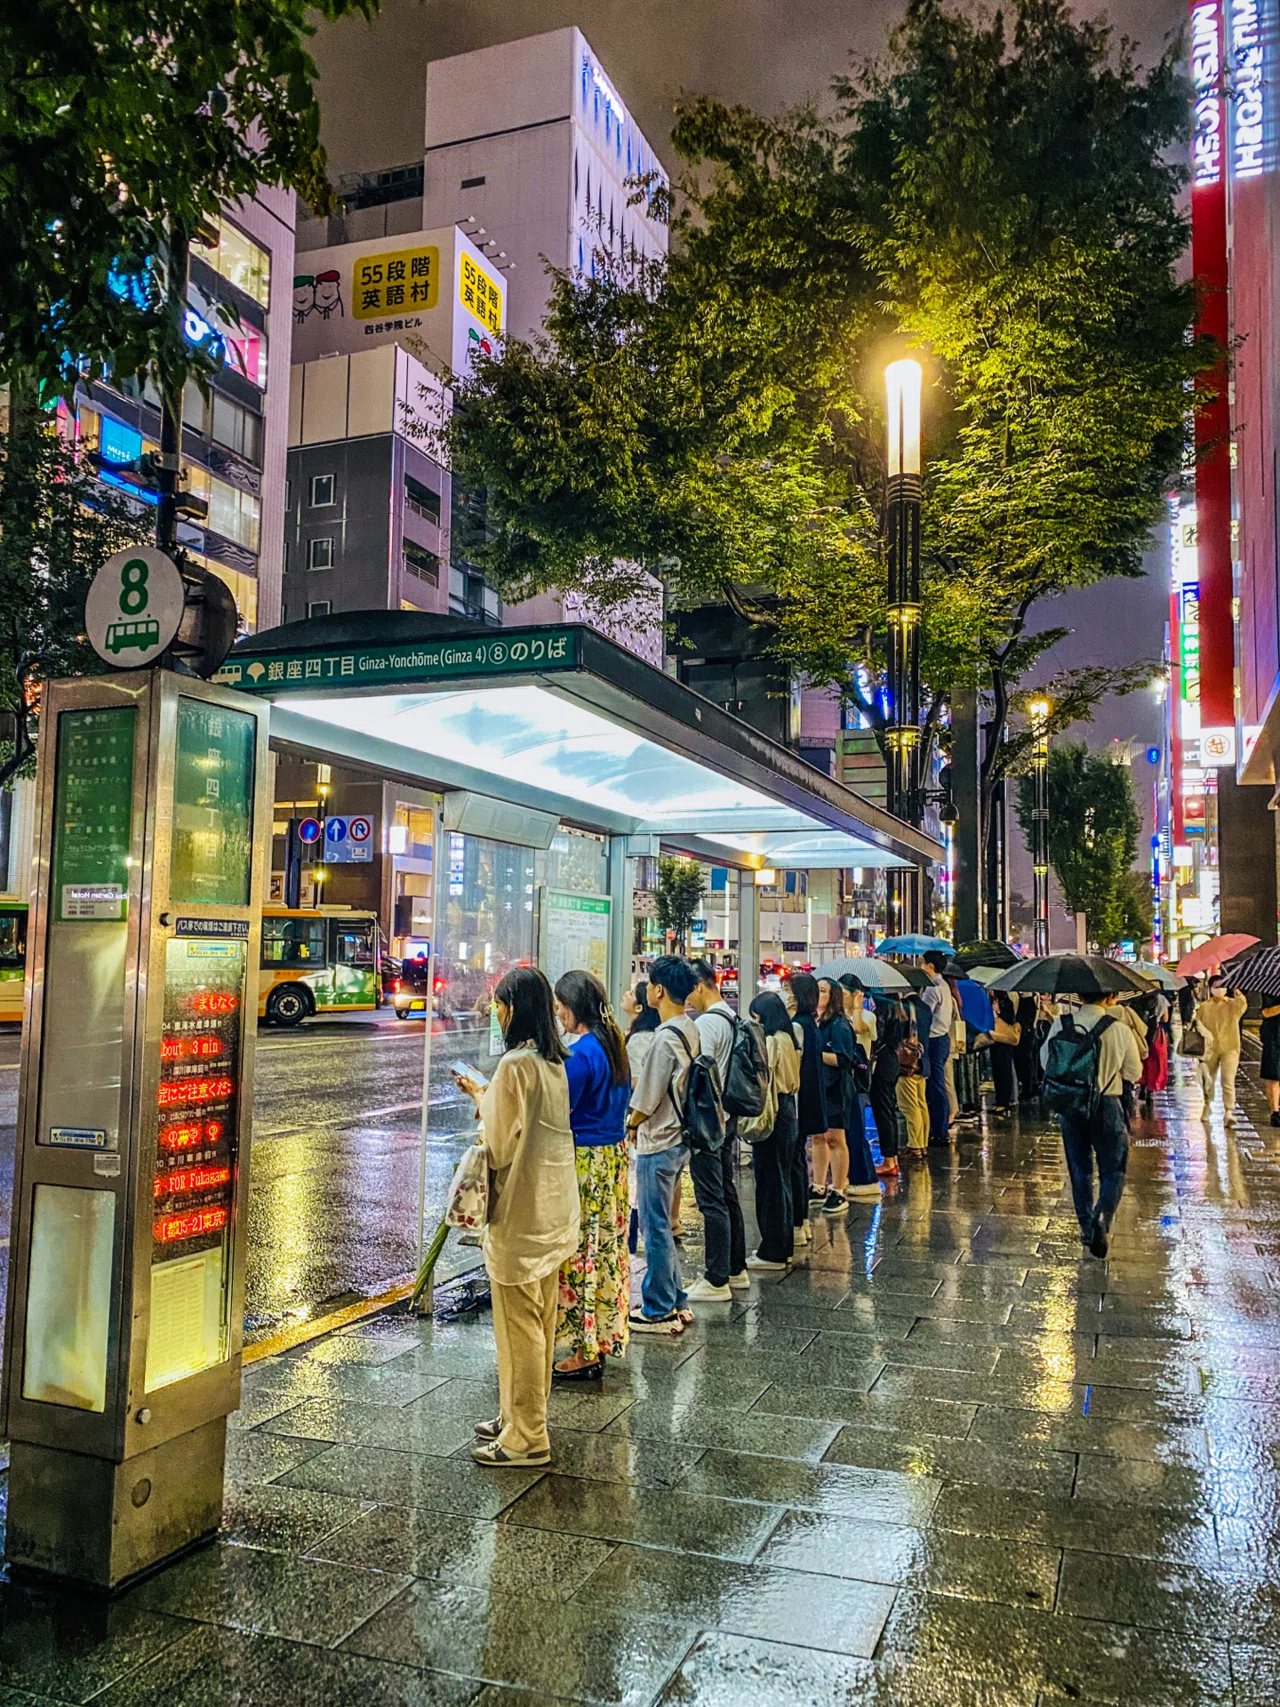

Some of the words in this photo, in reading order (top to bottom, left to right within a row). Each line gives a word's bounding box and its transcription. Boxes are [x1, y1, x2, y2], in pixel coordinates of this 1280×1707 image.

[361, 256, 430, 286] 55段階
[464, 261, 498, 309] 55段階
[362, 280, 430, 310] 英語村
[464, 284, 497, 331] 英語村
[364, 317, 423, 335] 四谷学院ビル
[119, 559, 149, 615] 8
[267, 655, 355, 681] 銀座四丁目
[358, 648, 439, 671] Ginza-Yonchōme
[440, 648, 473, 667] (Ginza
[475, 645, 487, 664] 4)
[204, 718, 223, 858] 銀座四丁目
[198, 995, 235, 1010] まもなく
[192, 1040, 199, 1054] 3
[202, 1038, 219, 1053] min
[169, 1174, 186, 1192] FOR
